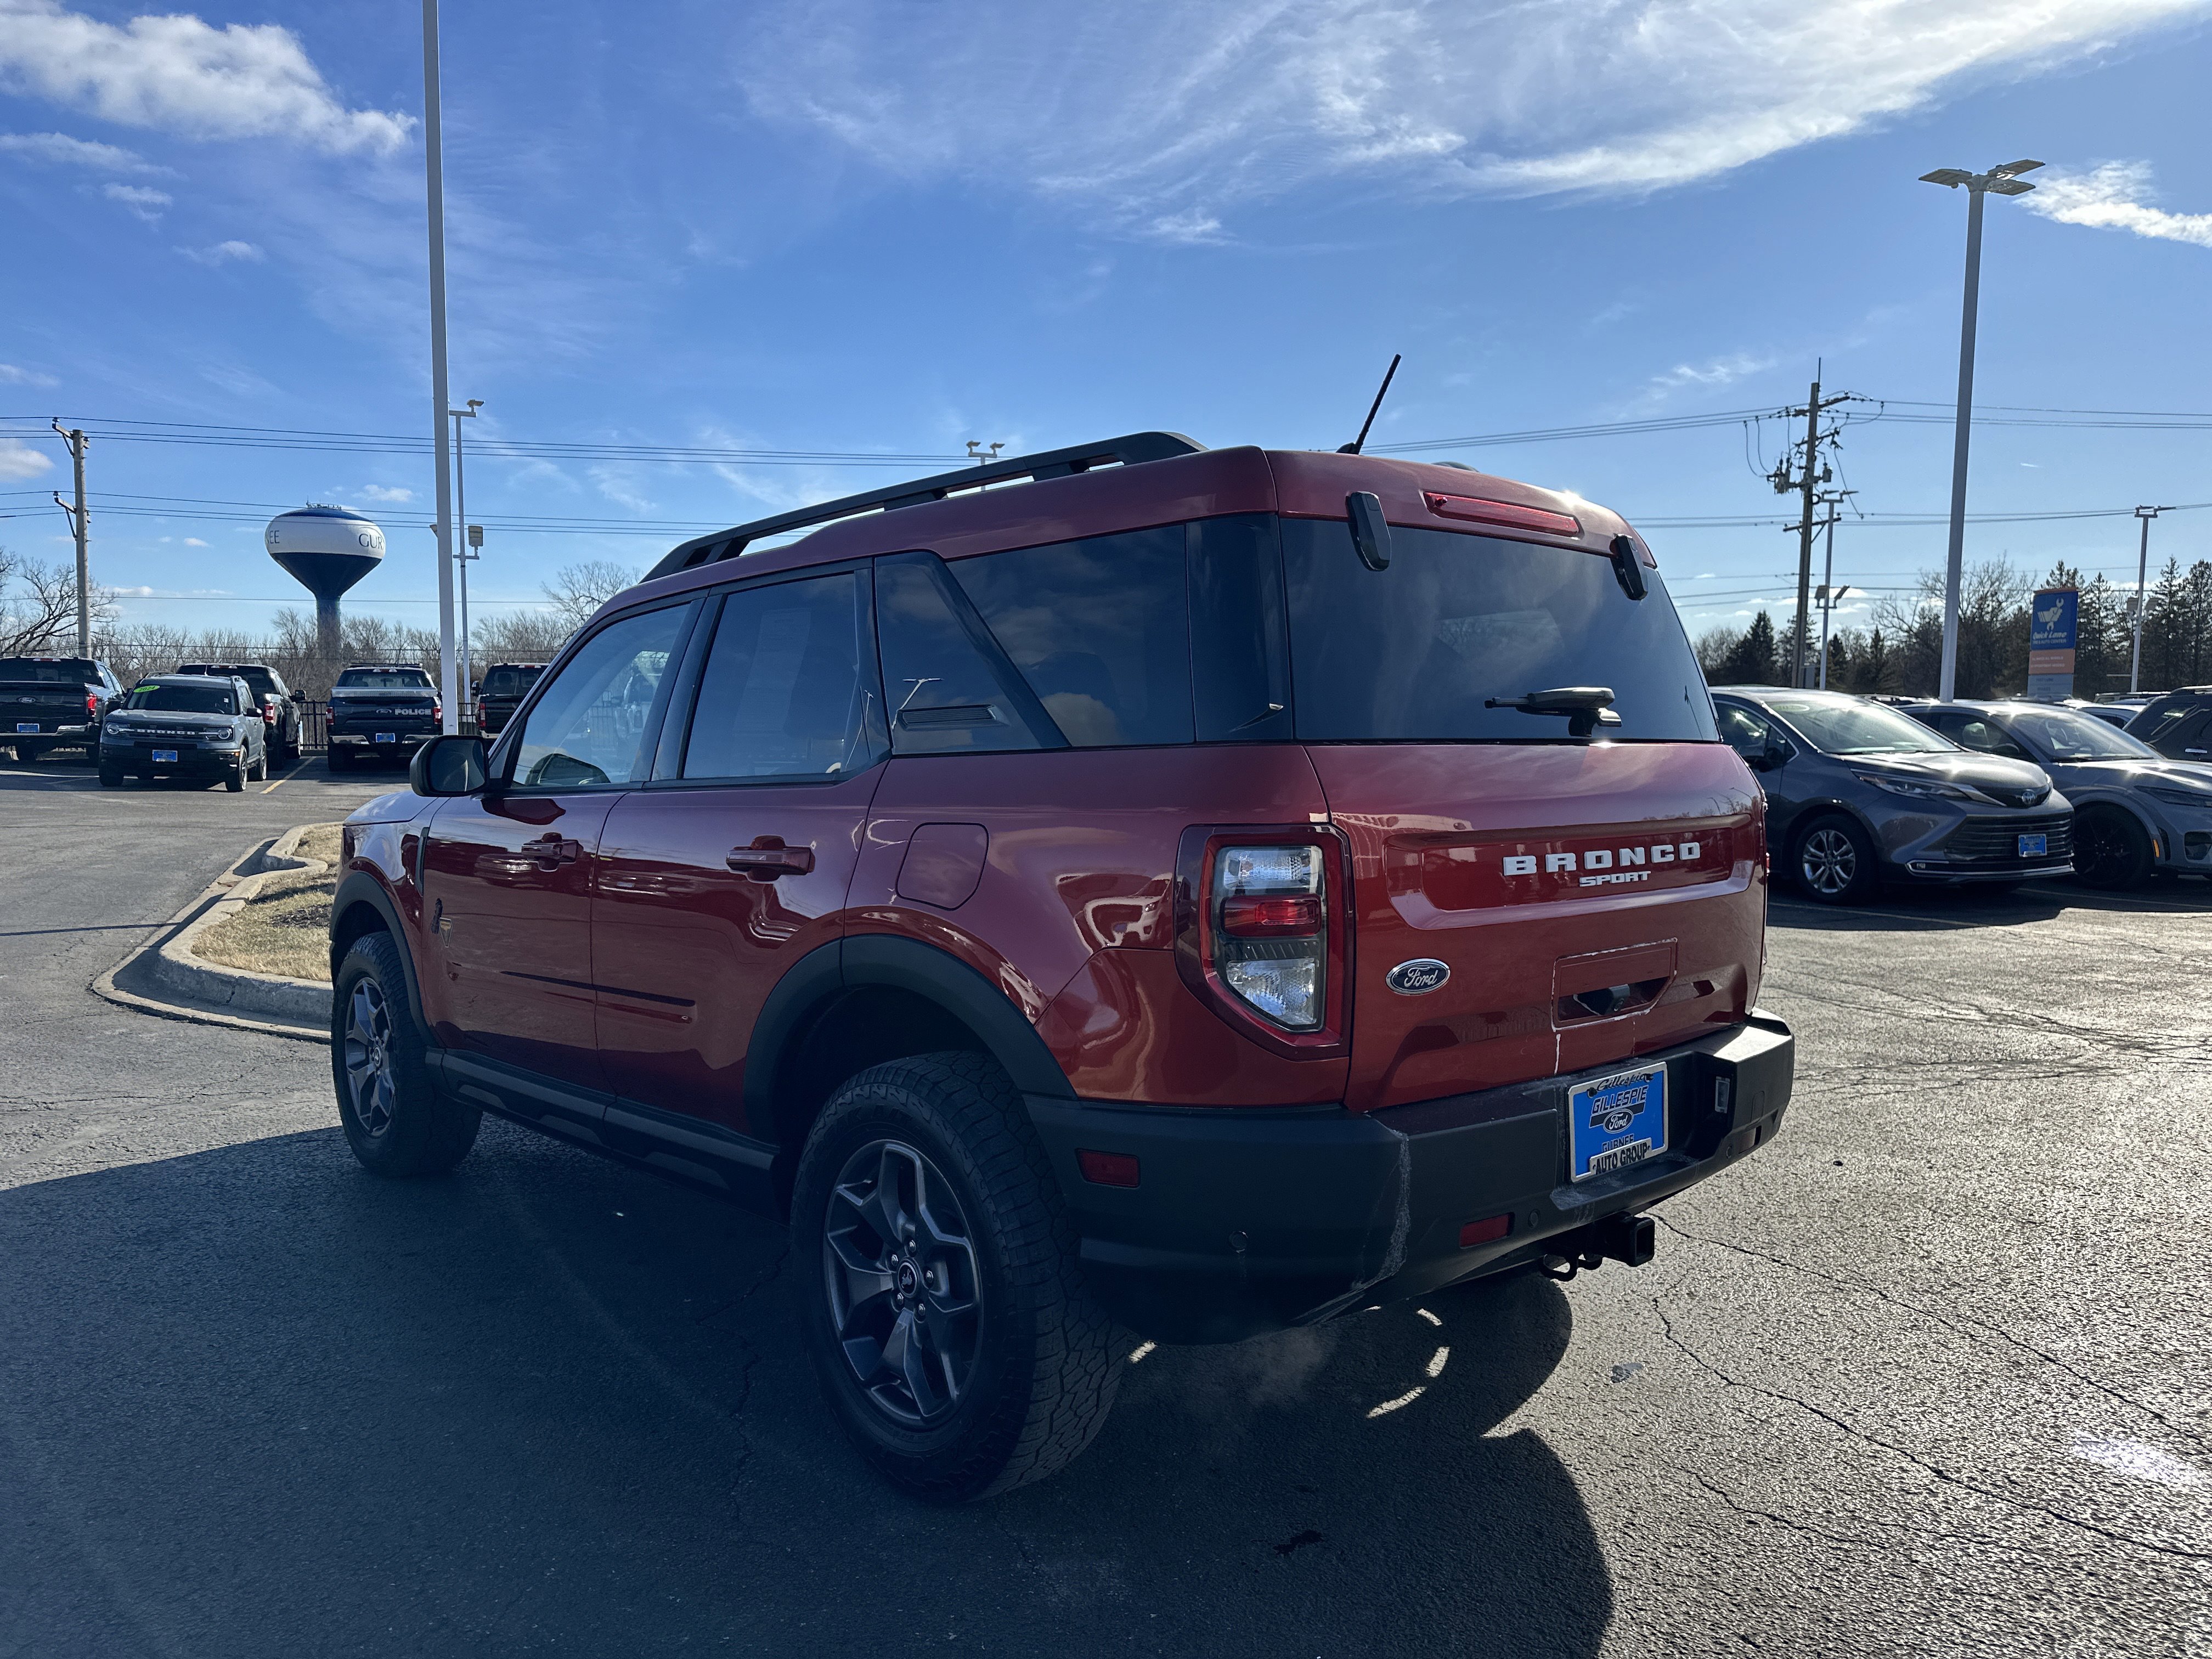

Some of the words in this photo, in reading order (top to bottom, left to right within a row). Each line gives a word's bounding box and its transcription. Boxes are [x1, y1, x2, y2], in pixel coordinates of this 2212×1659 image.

[2033, 631, 2048, 640] Quick
[1503, 841, 1701, 877] BRONCO
[1579, 870, 1651, 888] SPORT
[1403, 966, 1438, 988] Ford
[1596, 1073, 1648, 1092] Gillespie
[1592, 1085, 1649, 1115] GILLESPIE
[1609, 1113, 1628, 1130] Ford
[1595, 1153, 1618, 1175] AUTO
[1620, 1142, 1647, 1166] GROUP
